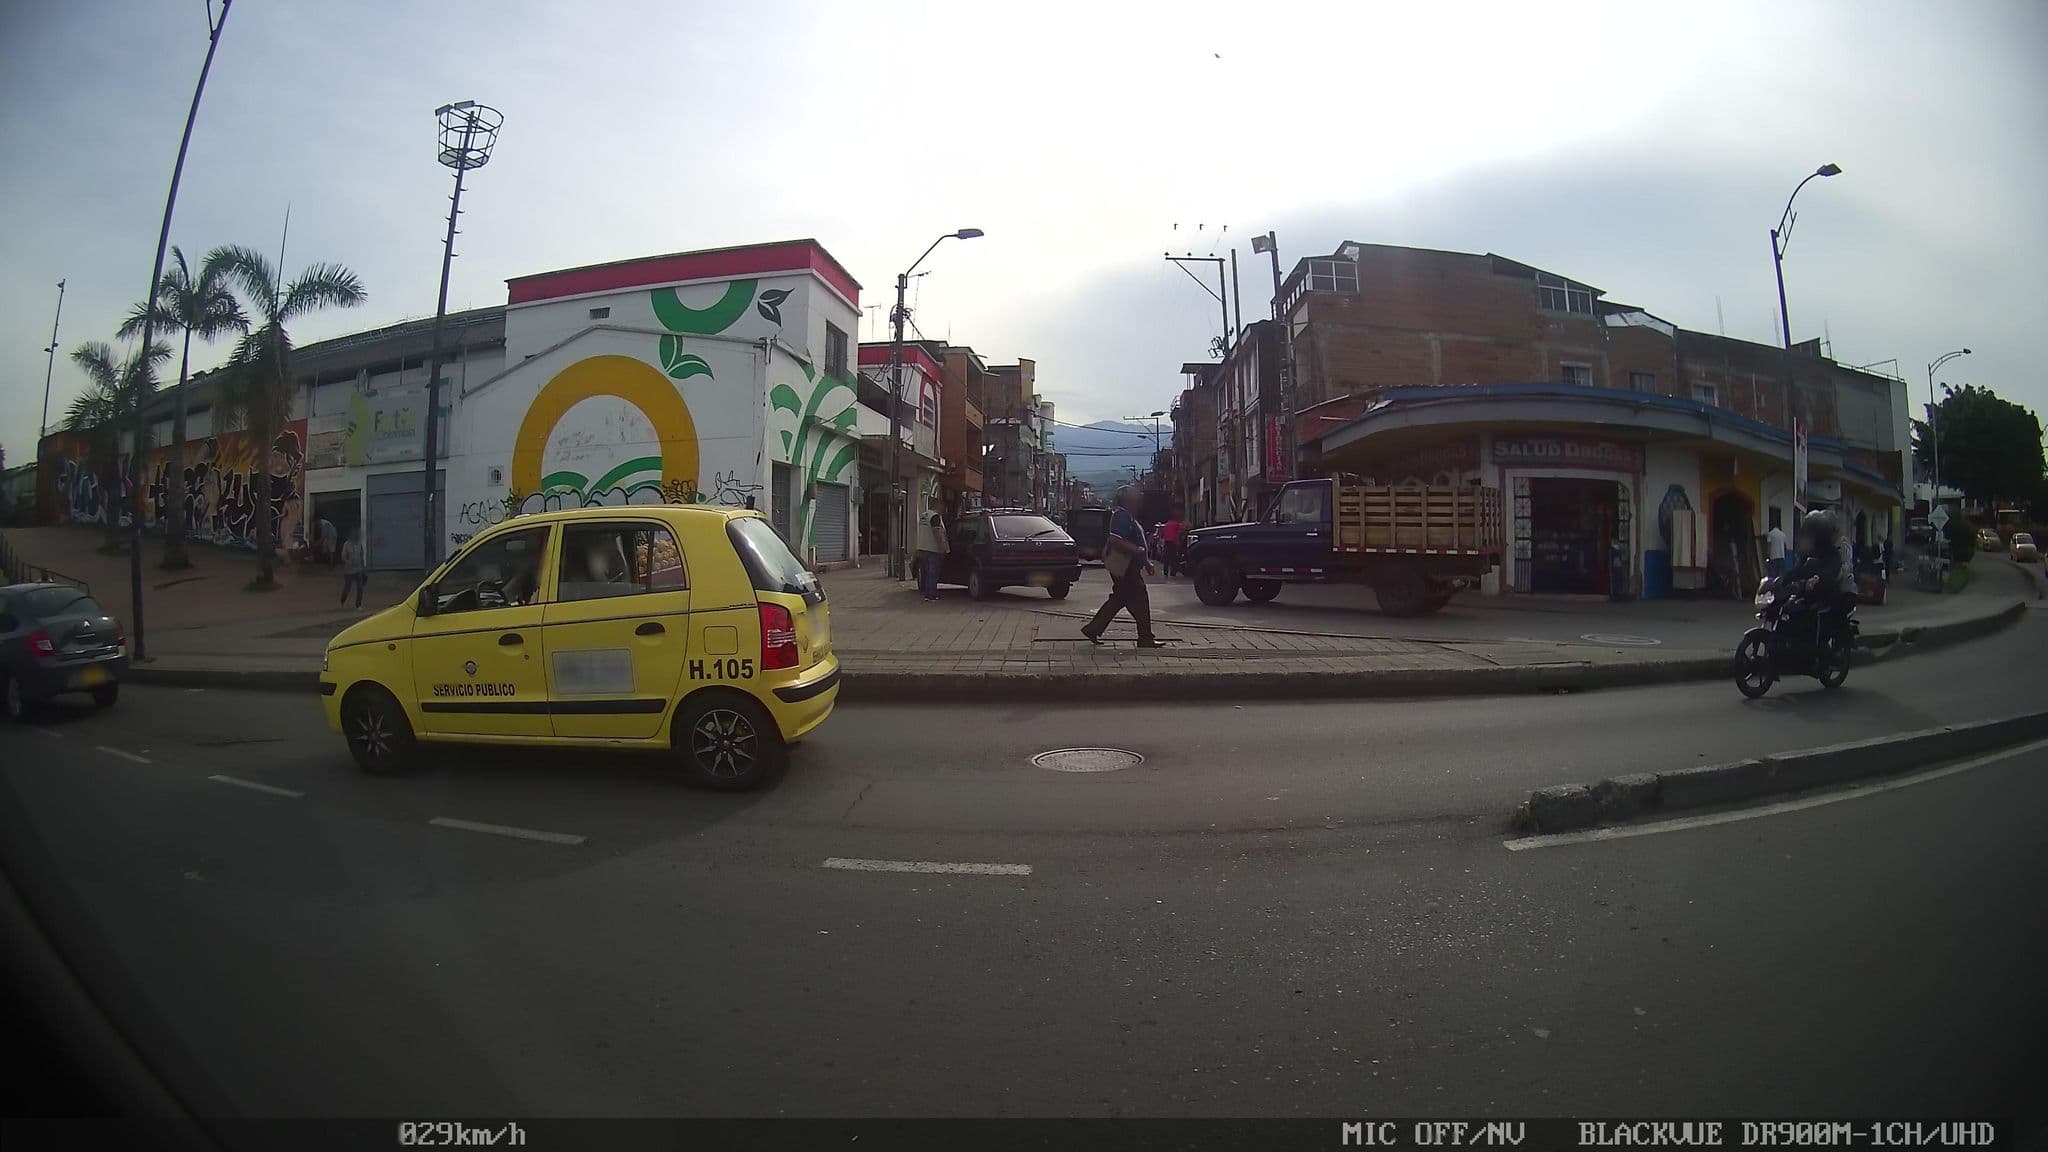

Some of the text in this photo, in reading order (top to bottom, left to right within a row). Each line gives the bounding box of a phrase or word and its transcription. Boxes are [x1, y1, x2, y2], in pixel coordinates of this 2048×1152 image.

[1494, 440, 1561, 457] SALUD
[689, 658, 754, 680] H.105
[433, 683, 516, 697] SERVICIO PUBLICO
